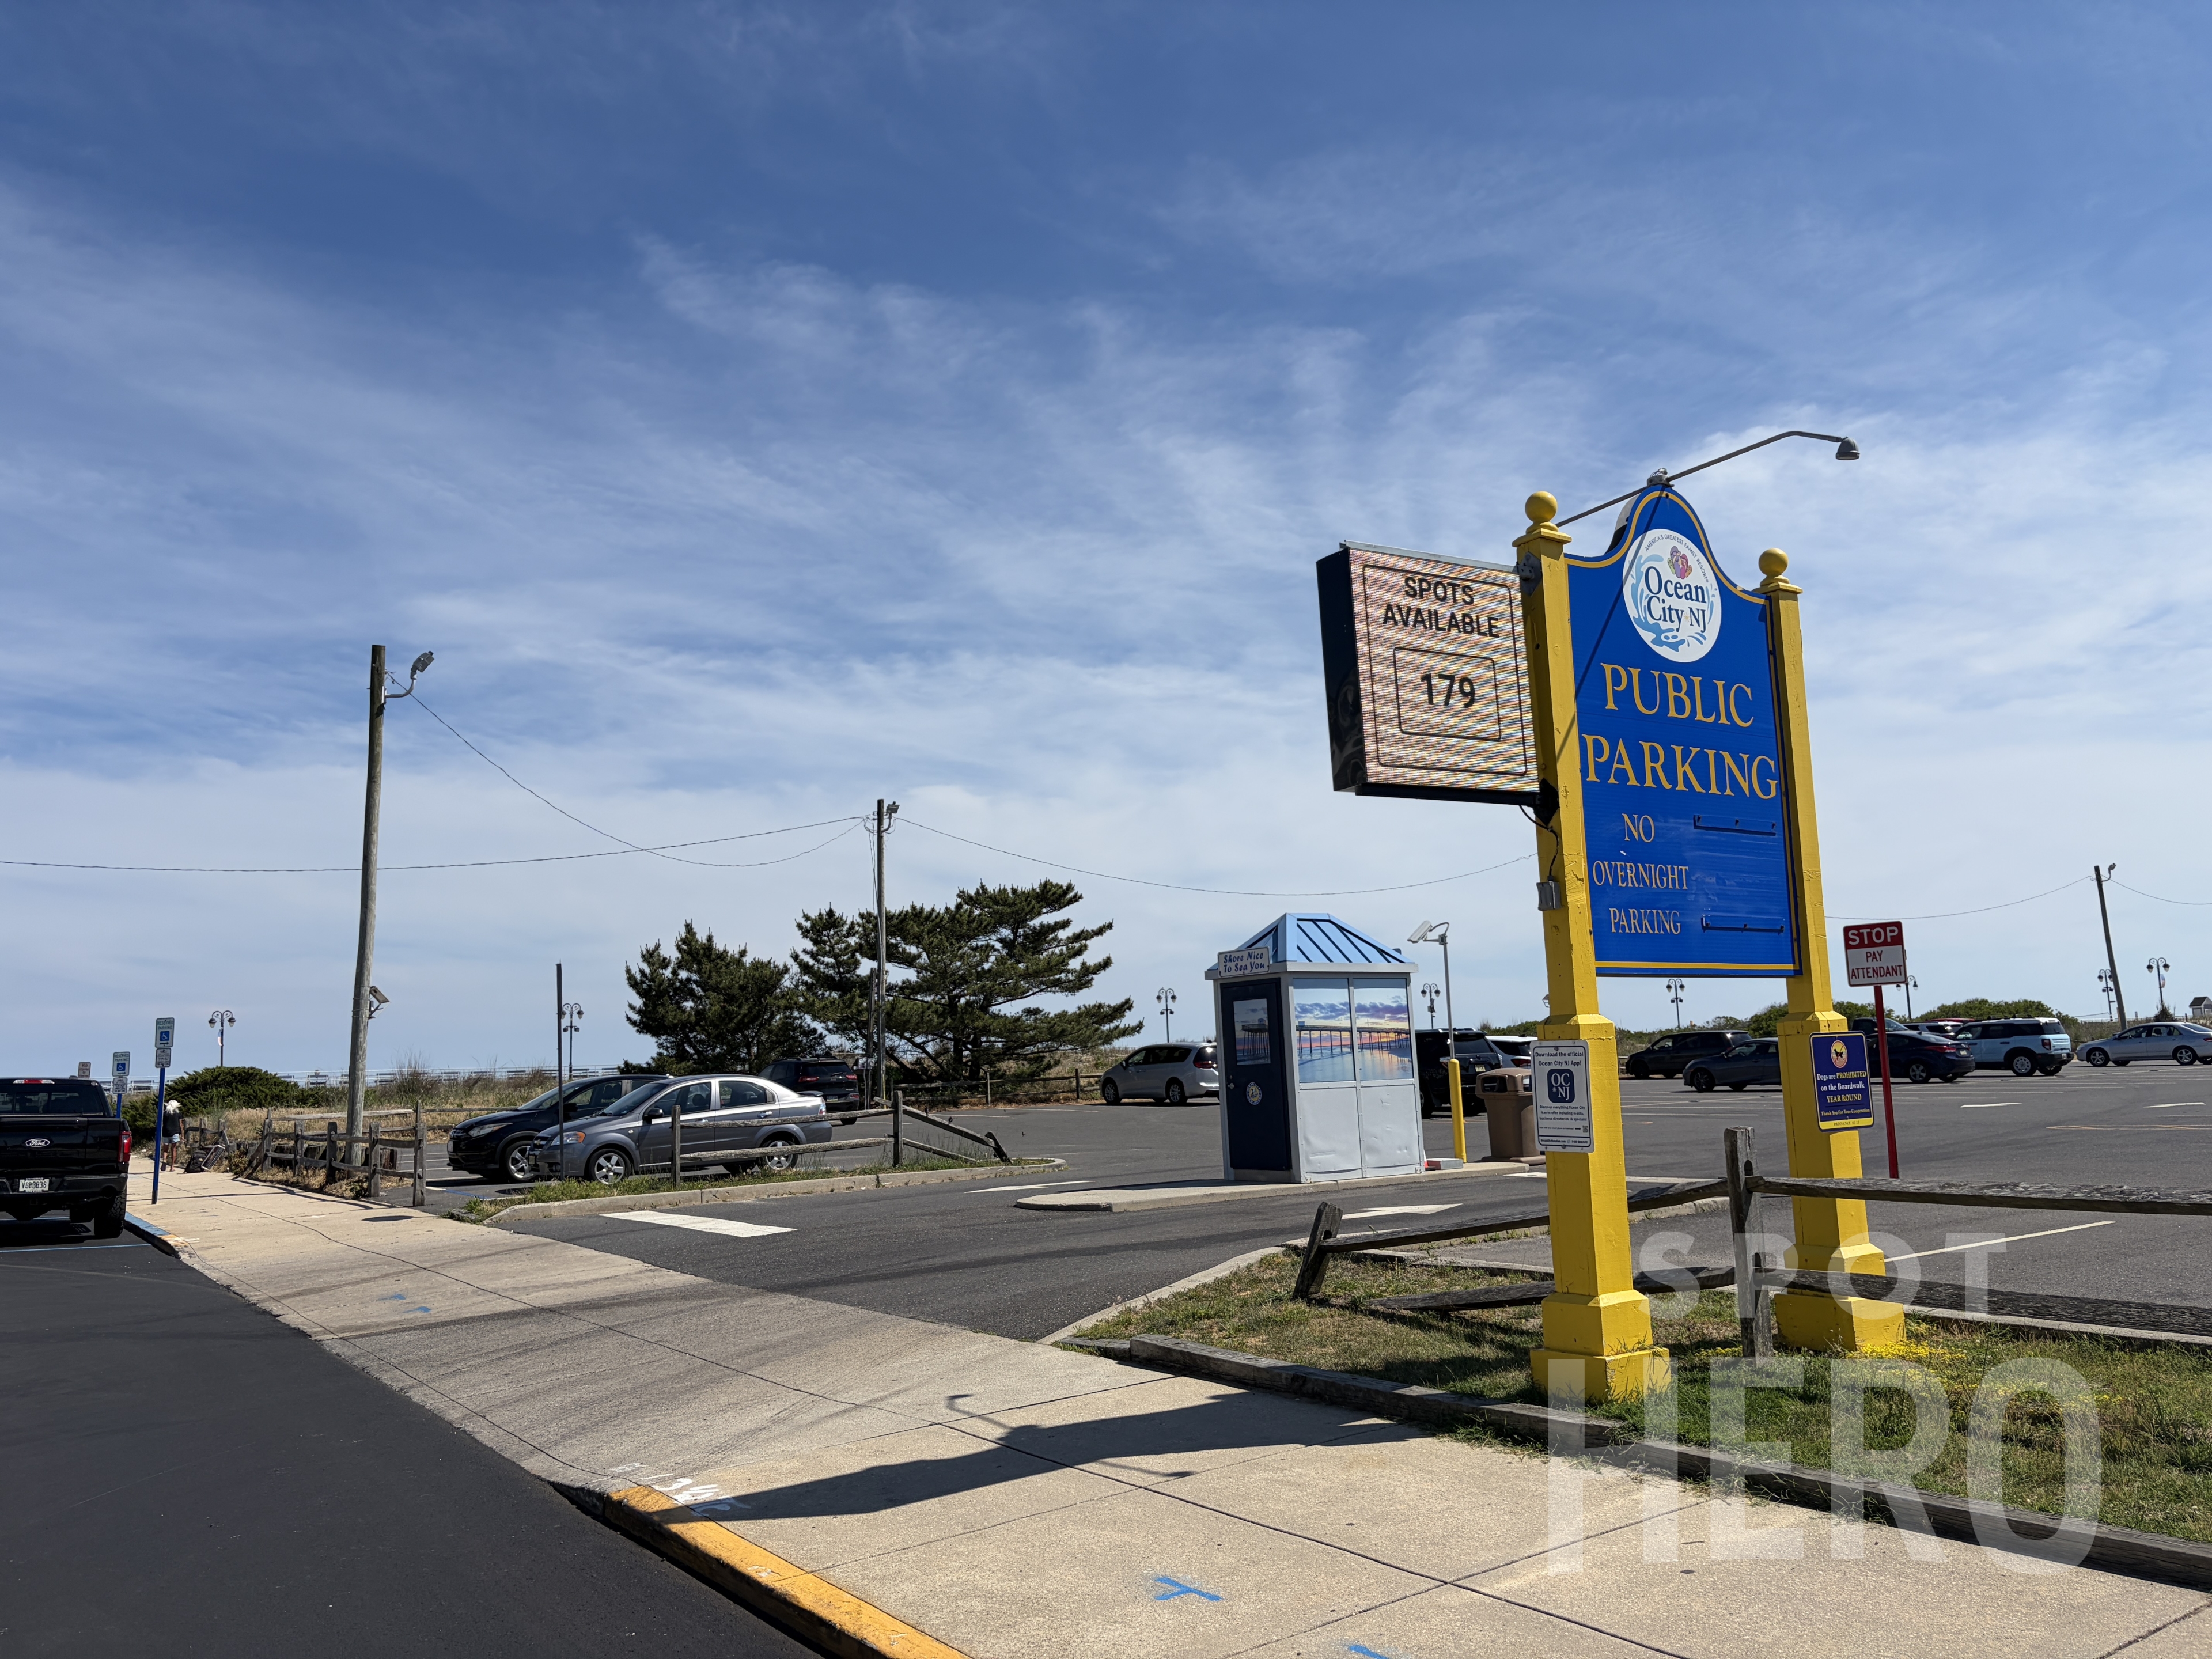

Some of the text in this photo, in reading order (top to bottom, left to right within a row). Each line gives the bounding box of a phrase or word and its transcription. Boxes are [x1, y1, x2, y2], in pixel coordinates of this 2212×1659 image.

[1645, 535, 1664, 552] AMERICA'S
[1664, 534, 1683, 544] GREATEST
[1684, 543, 1697, 558] FAMILY
[1404, 577, 1474, 605] SPOTS
[1645, 566, 1707, 603] Ocean
[1382, 603, 1500, 638] AVAILABLE
[1647, 596, 1706, 633] City NJ
[1421, 673, 1475, 709] 179
[1600, 662, 1754, 728] PUBLIC
[1581, 733, 1778, 800] PARKING
[1622, 813, 1655, 843] NO
[1593, 861, 1689, 890] OVERNIGHT
[1609, 908, 1681, 935] PARKING
[1848, 926, 1899, 945] STOP
[1224, 951, 1263, 964] Shore Nice
[1224, 961, 1264, 973] To Sea You
[1865, 950, 1883, 963] PAY
[1851, 965, 1903, 979] ATTENDANT
[1551, 1073, 1570, 1086] OC
[1817, 1073, 1828, 1081] Dogs
[1836, 1071, 1866, 1079] PROHIBITED
[1828, 1083, 1836, 1091] the
[1837, 1081, 1865, 1090] Boardwalk
[1557, 1086, 1570, 1101] NJ
[1842, 1093, 1862, 1101] ROUND
